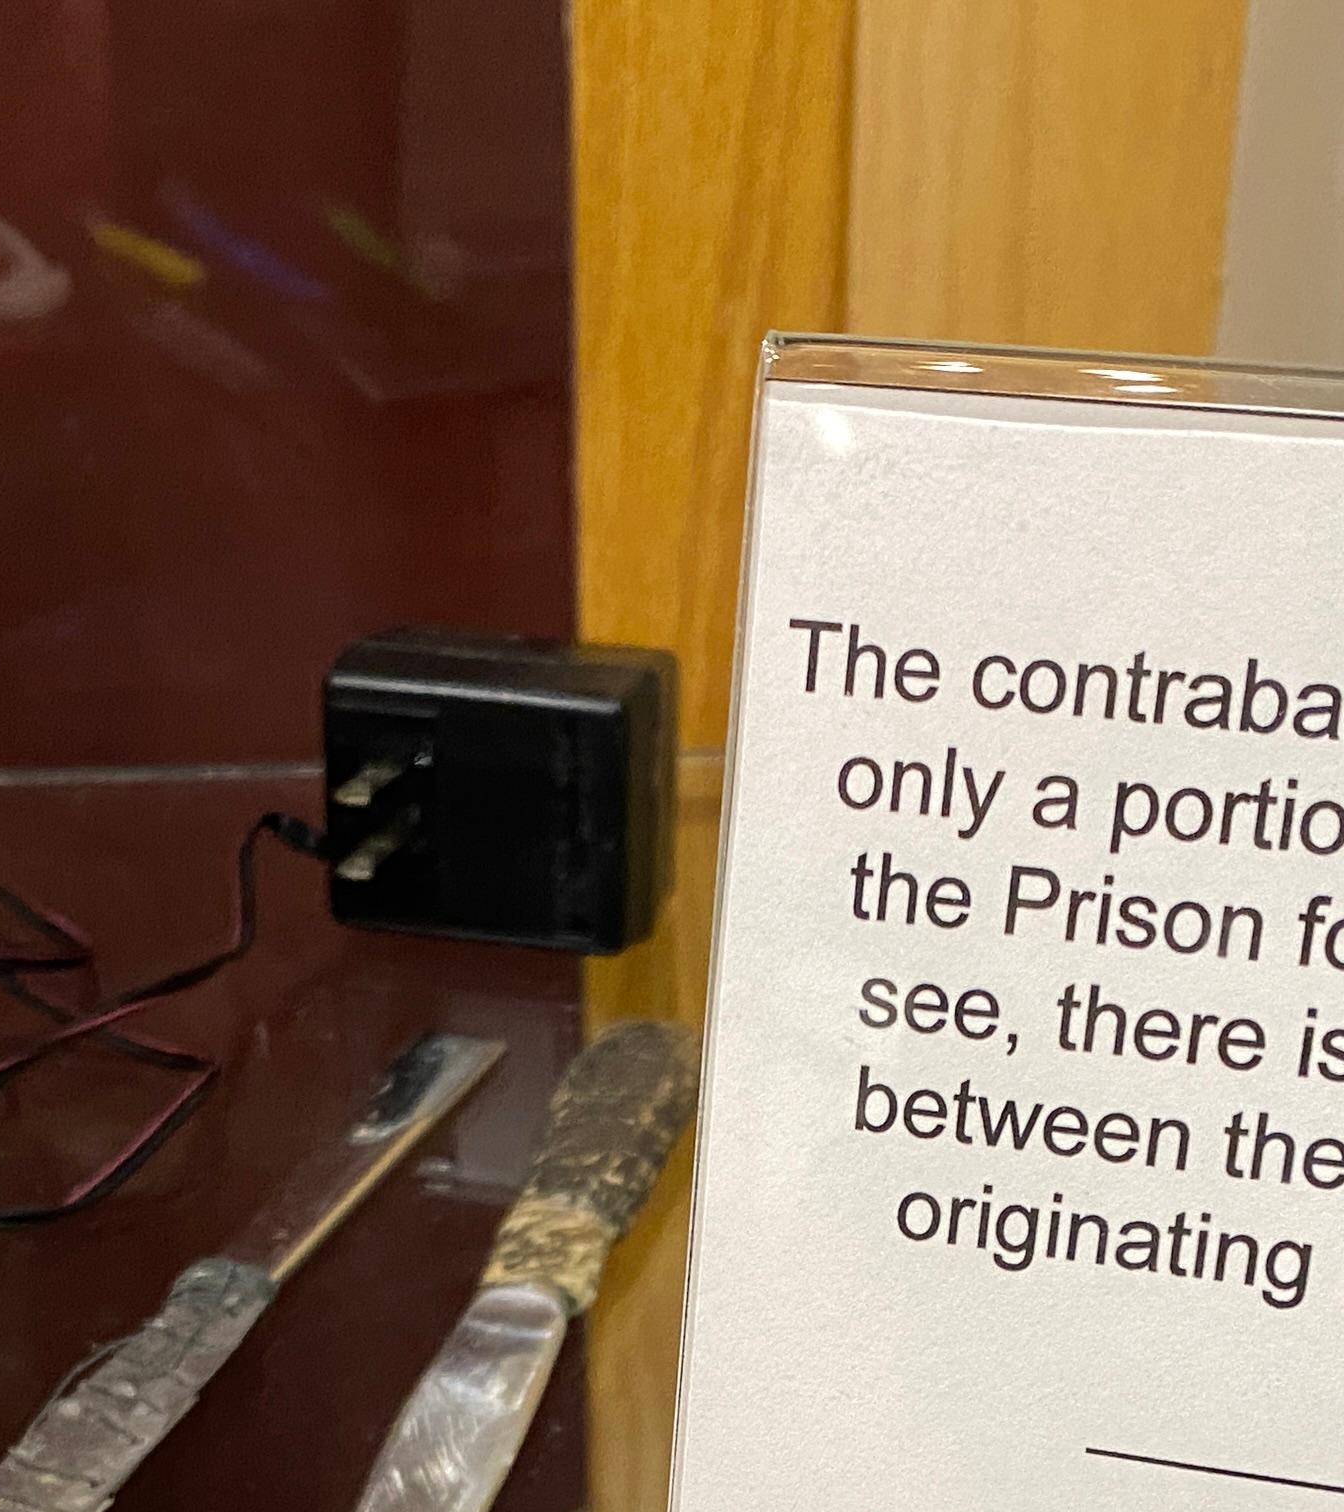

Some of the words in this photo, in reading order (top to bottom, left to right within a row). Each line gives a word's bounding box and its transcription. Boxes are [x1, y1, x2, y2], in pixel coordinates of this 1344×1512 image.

[788, 617, 941, 704] The
[837, 746, 1007, 841] only
[1031, 774, 1079, 831] a
[849, 851, 972, 930] the
[1003, 864, 1264, 962] Prison
[858, 977, 1019, 1057] see,
[1056, 983, 1267, 1072] there
[853, 1064, 1191, 1172] between
[896, 1191, 1314, 1310] originating
